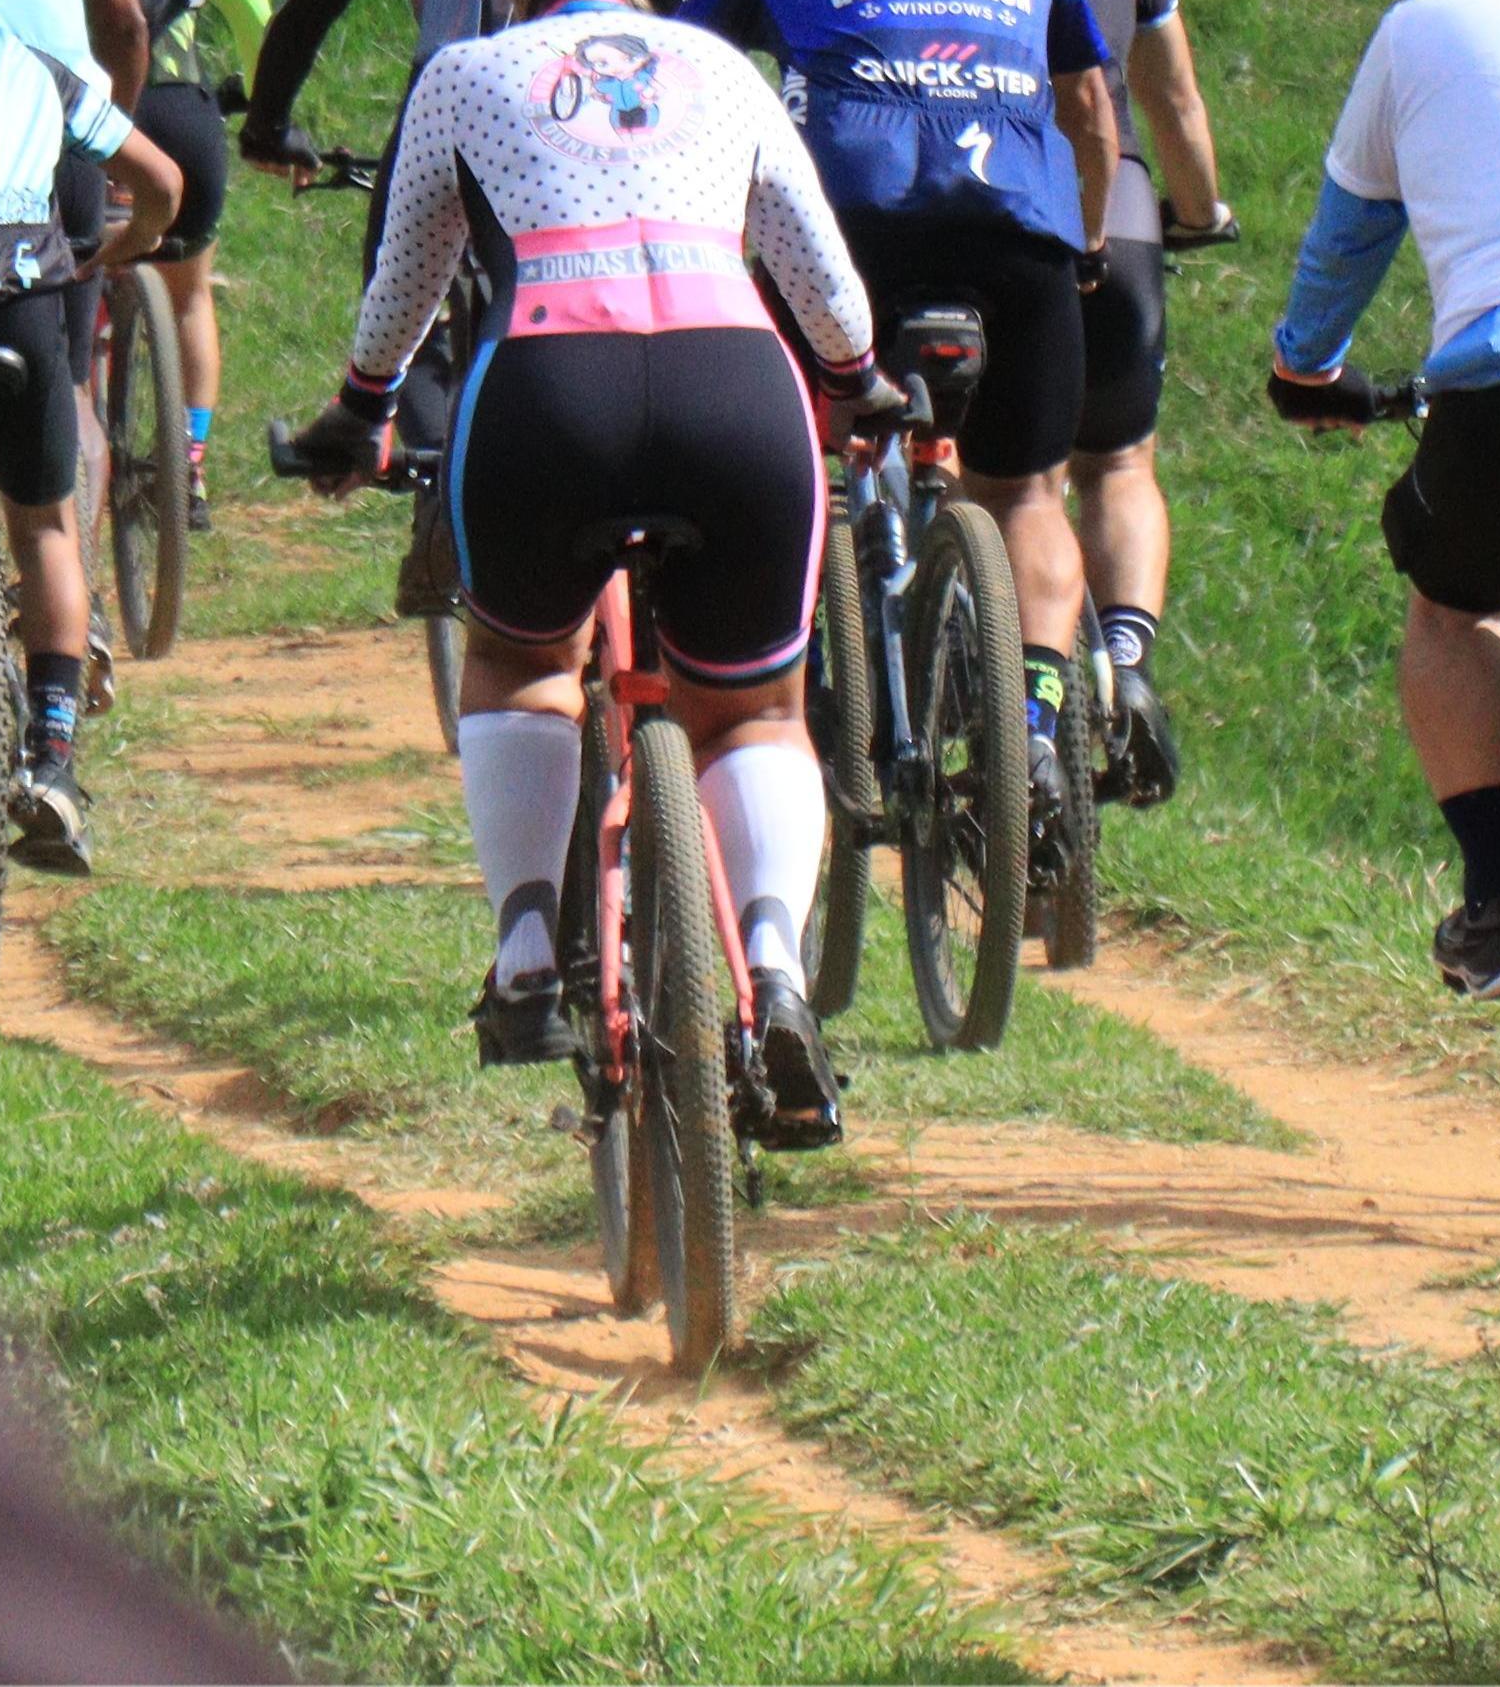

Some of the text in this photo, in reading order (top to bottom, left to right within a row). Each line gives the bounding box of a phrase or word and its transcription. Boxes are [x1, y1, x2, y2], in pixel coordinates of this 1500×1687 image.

[888, 1, 993, 20] WINDOWS
[928, 88, 978, 100] FLOORS
[541, 251, 626, 280] DUNAS
